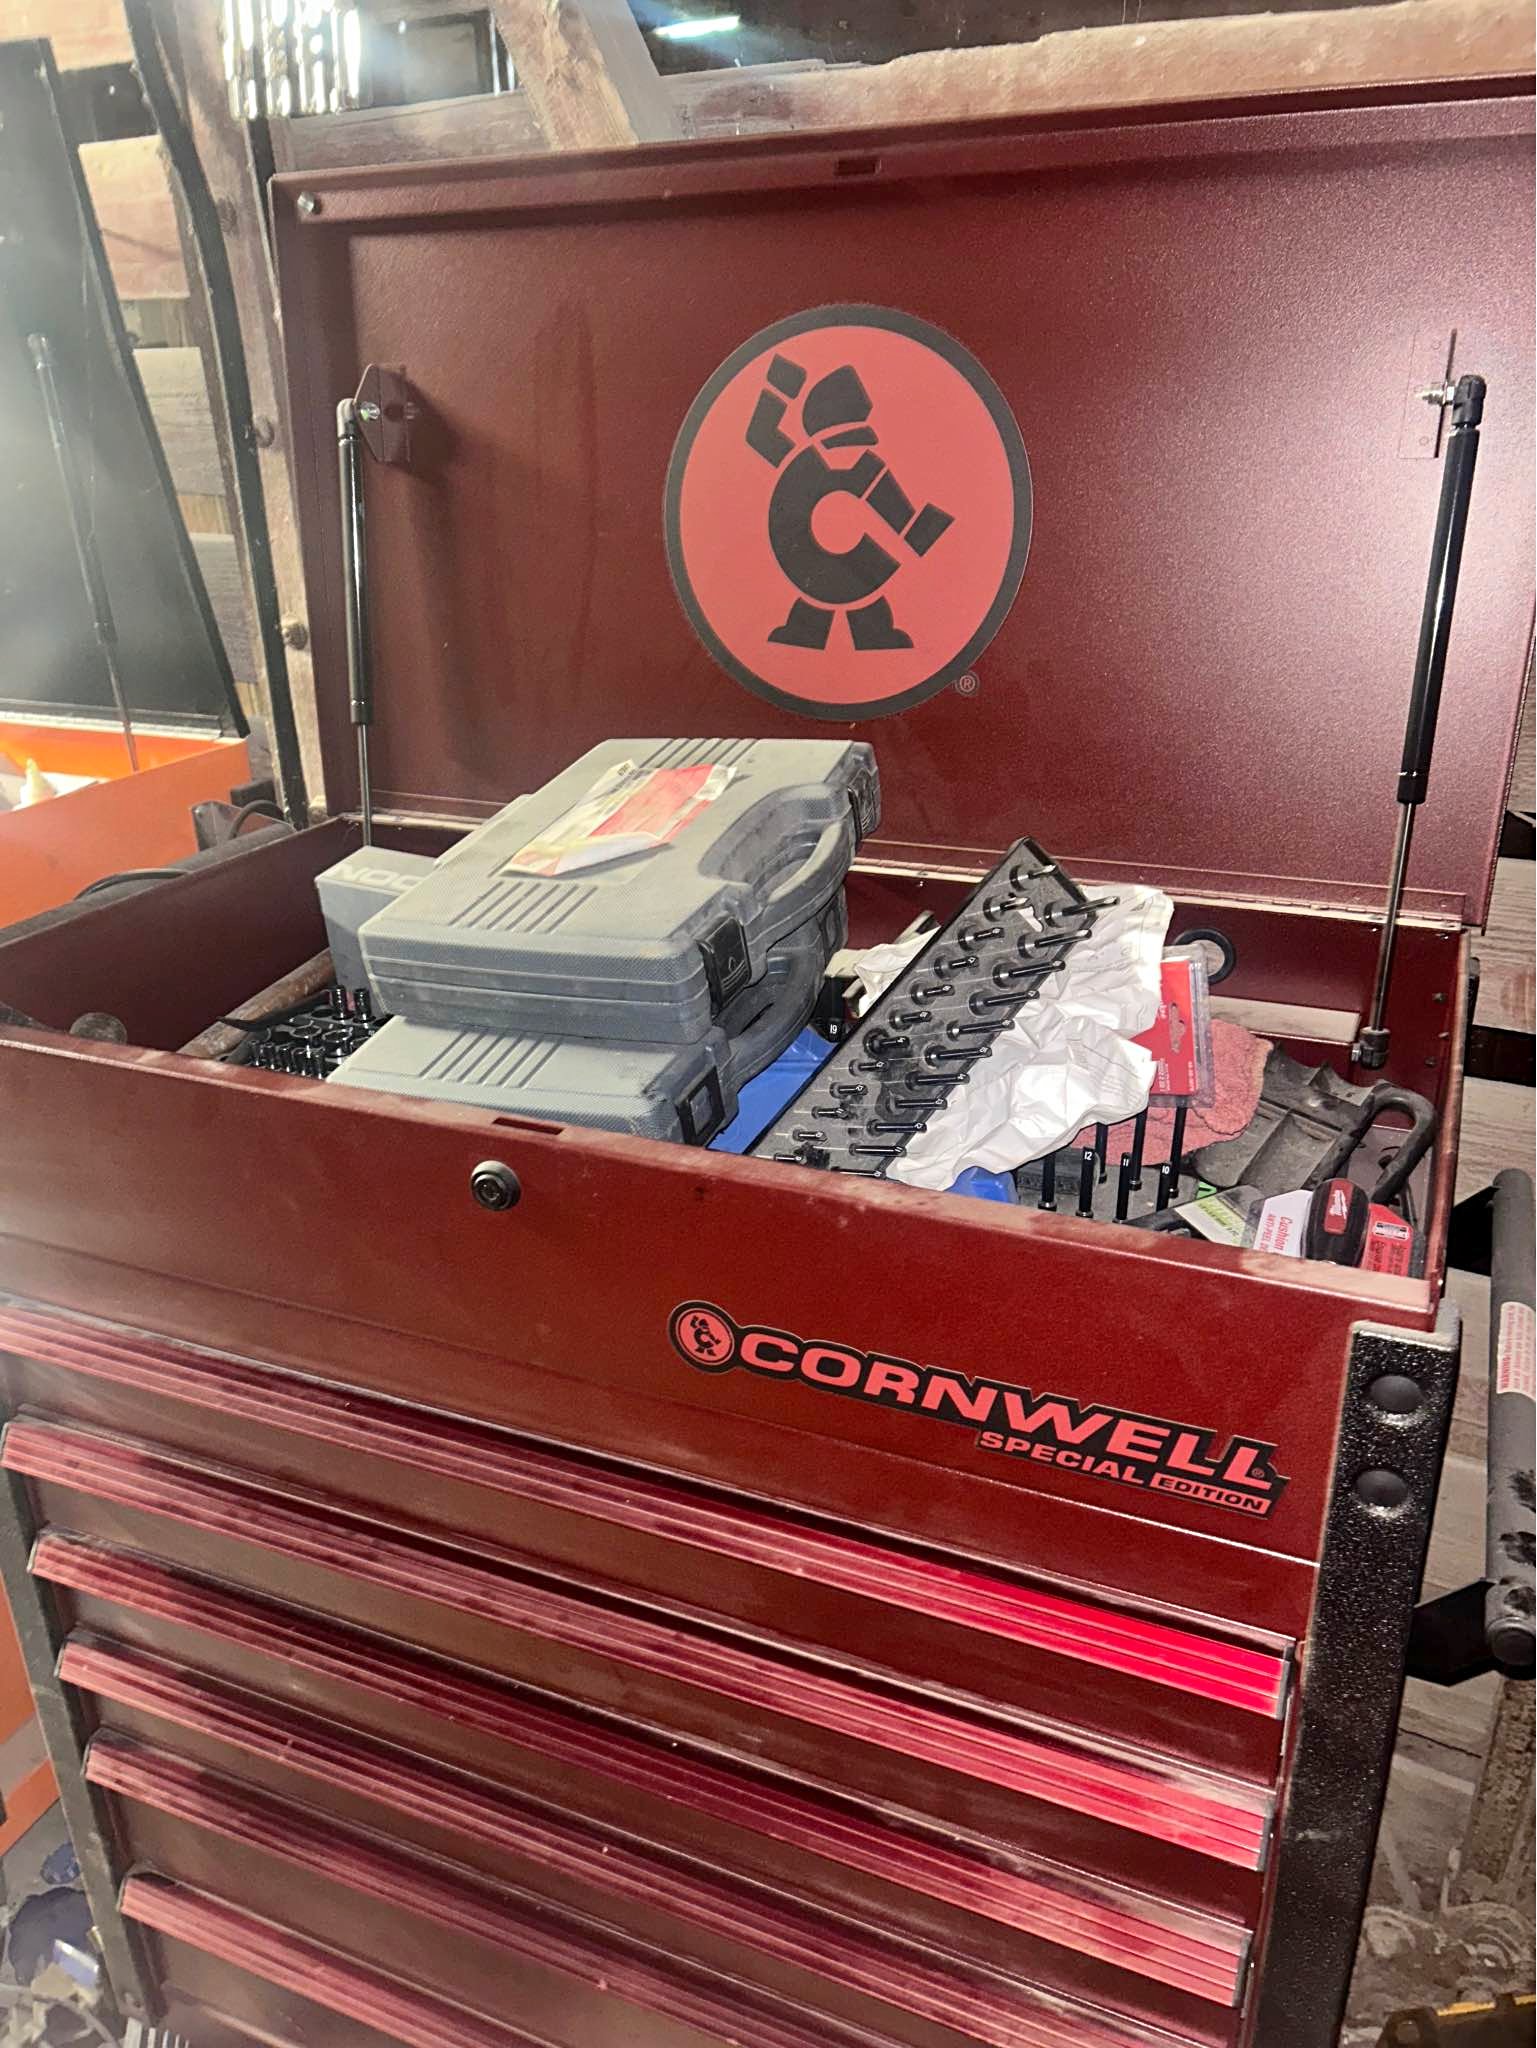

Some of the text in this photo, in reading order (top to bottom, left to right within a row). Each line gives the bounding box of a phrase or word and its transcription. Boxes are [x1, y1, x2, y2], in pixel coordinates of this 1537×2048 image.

[1084, 1151, 1093, 1161] 12
[1122, 1158, 1129, 1167] 11
[1161, 1165, 1170, 1175] 10
[1273, 1216, 1293, 1251] Cushion
[741, 1334, 1272, 1490] CORNWELL
[980, 1431, 1264, 1510] SPECIAL EDITION
